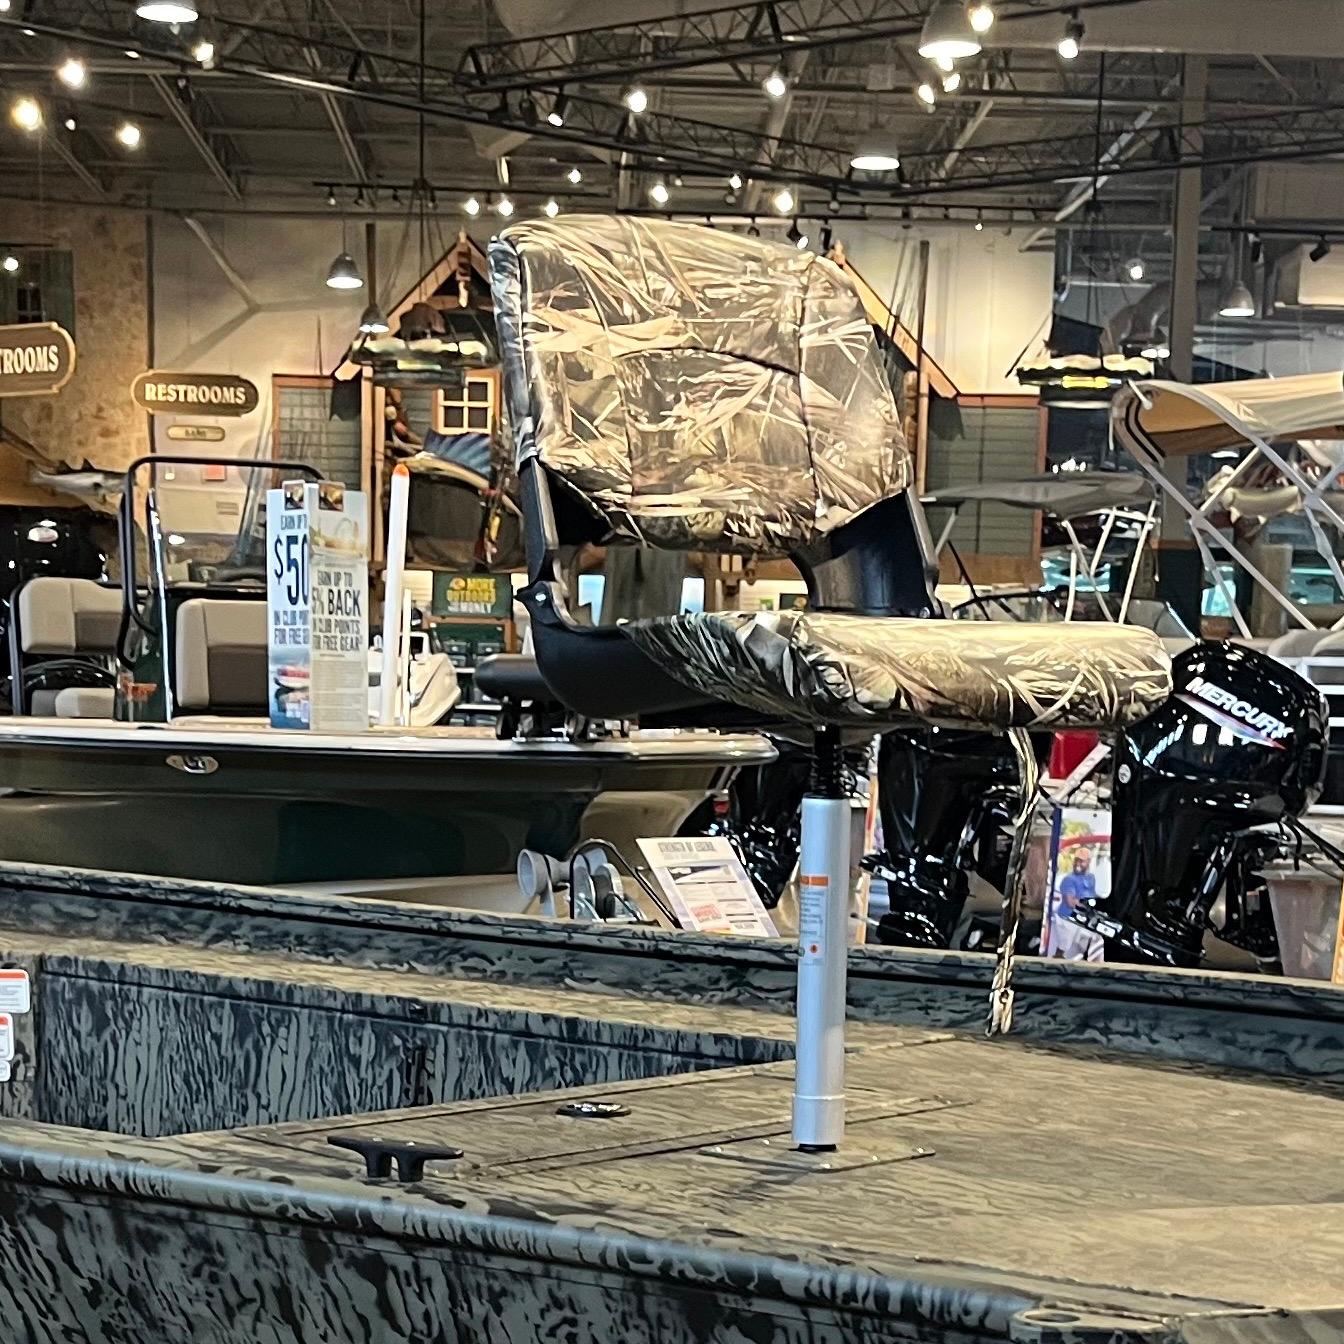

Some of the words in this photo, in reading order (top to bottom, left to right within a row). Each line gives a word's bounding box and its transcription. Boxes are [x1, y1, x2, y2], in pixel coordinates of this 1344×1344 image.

[144, 383, 246, 404] RESTROOMS
[328, 589, 361, 617] BACK
[1184, 676, 1294, 739] MERCURY
